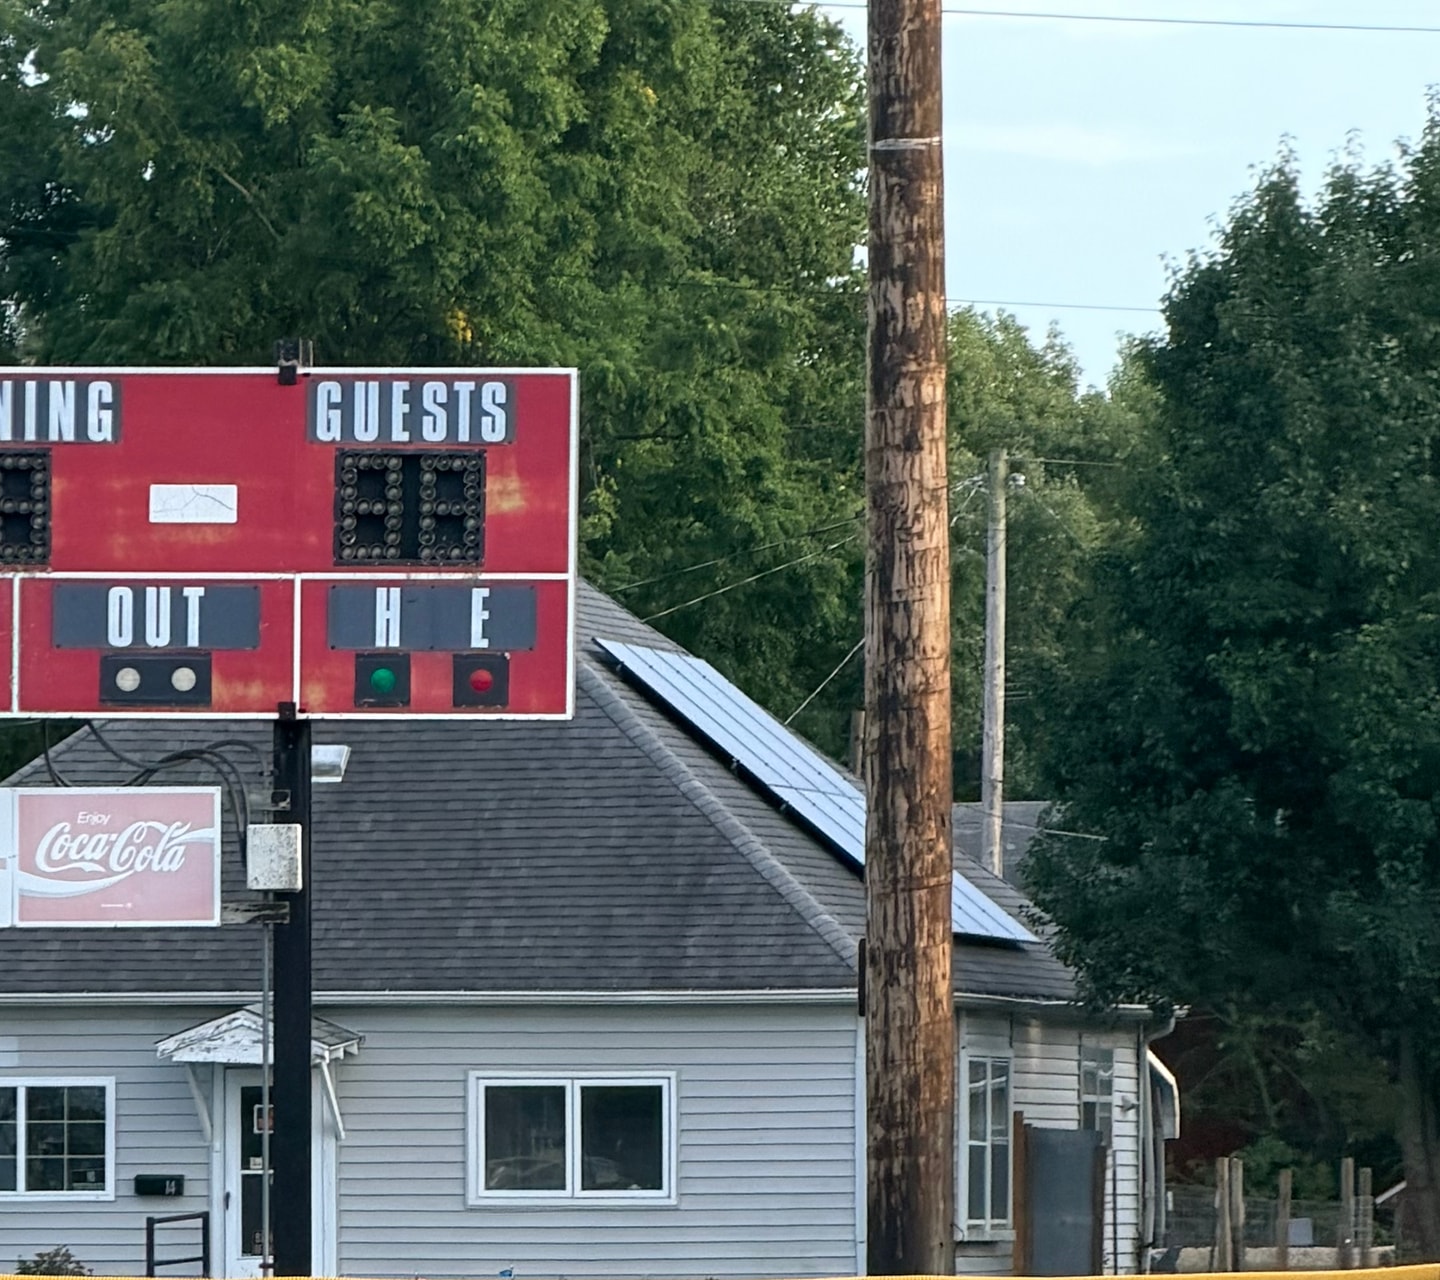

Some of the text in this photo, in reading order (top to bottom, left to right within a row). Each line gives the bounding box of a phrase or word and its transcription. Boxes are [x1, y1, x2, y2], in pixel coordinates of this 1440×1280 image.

[315, 380, 508, 443] GUESTS
[107, 586, 206, 648] OUT
[375, 587, 490, 648] H E
[35, 821, 191, 873] Coca-Cola
[77, 811, 112, 827] Enjoy
